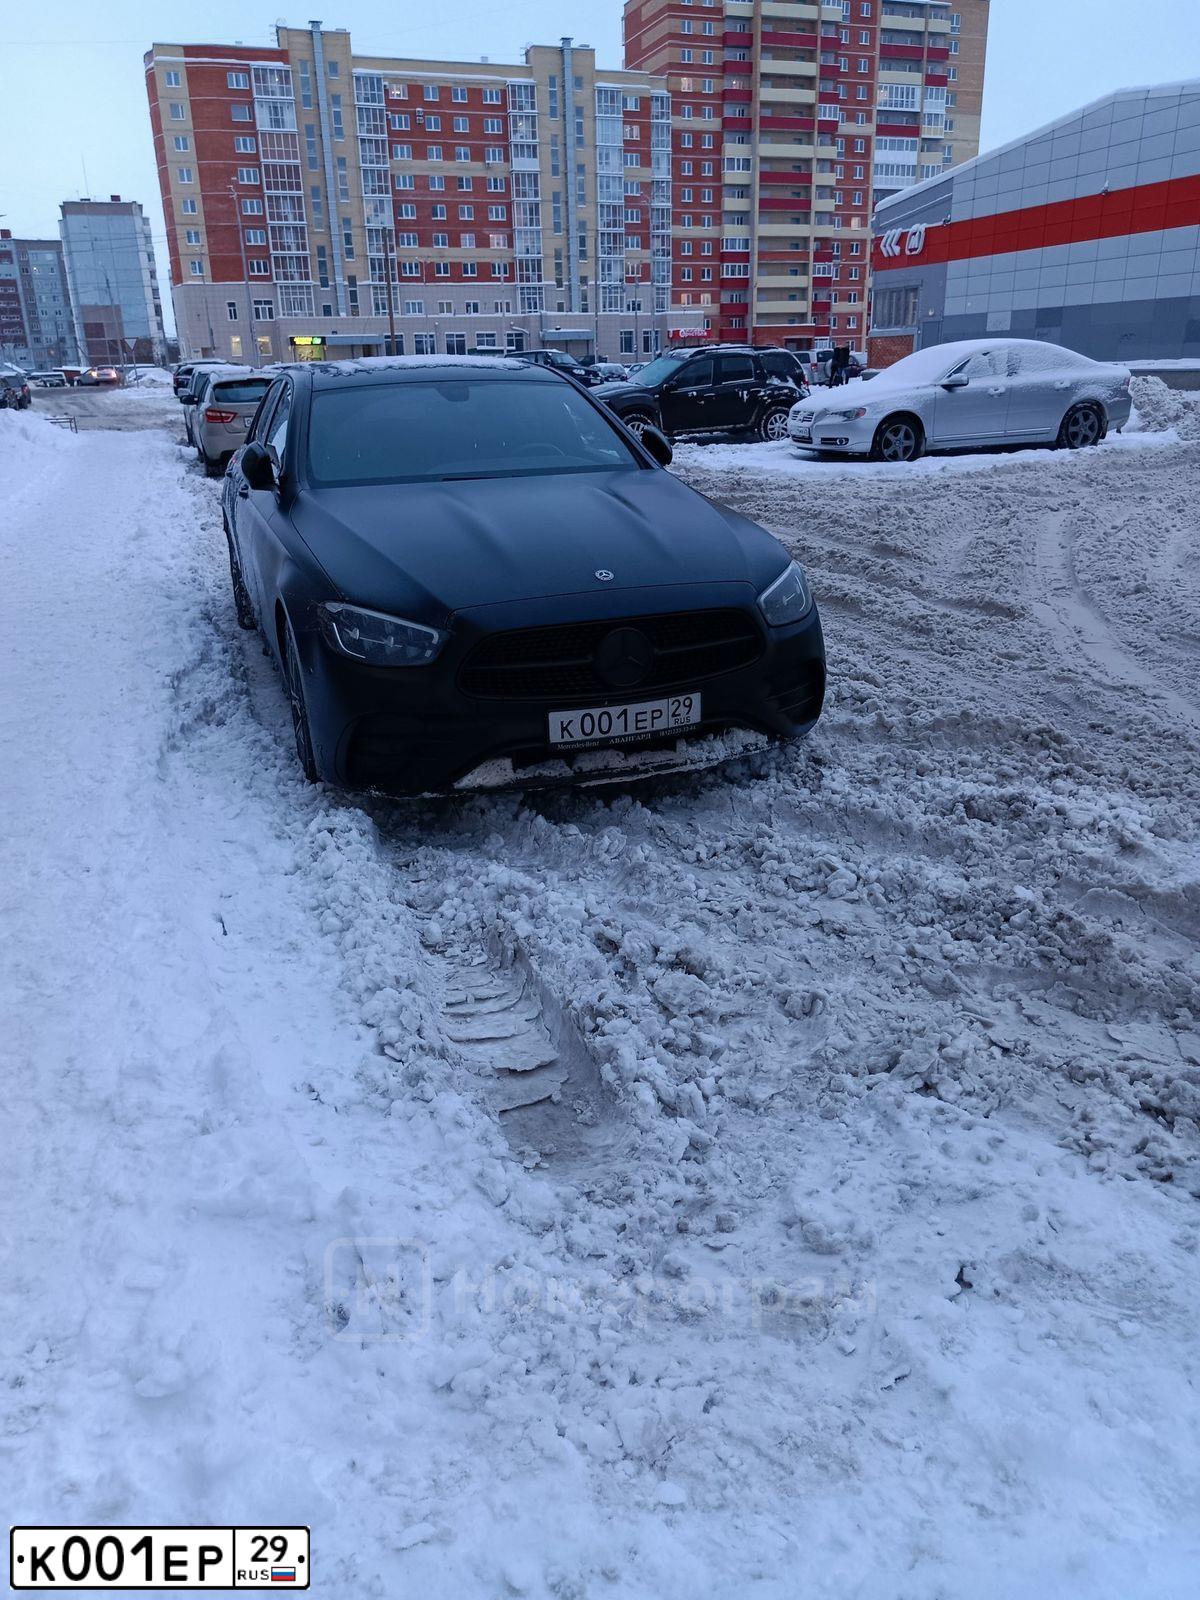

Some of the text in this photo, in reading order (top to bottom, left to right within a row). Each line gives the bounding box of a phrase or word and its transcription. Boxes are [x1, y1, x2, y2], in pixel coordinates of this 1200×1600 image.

[560, 696, 693, 739] К001ЕР 29
[674, 716, 691, 726] RUS
